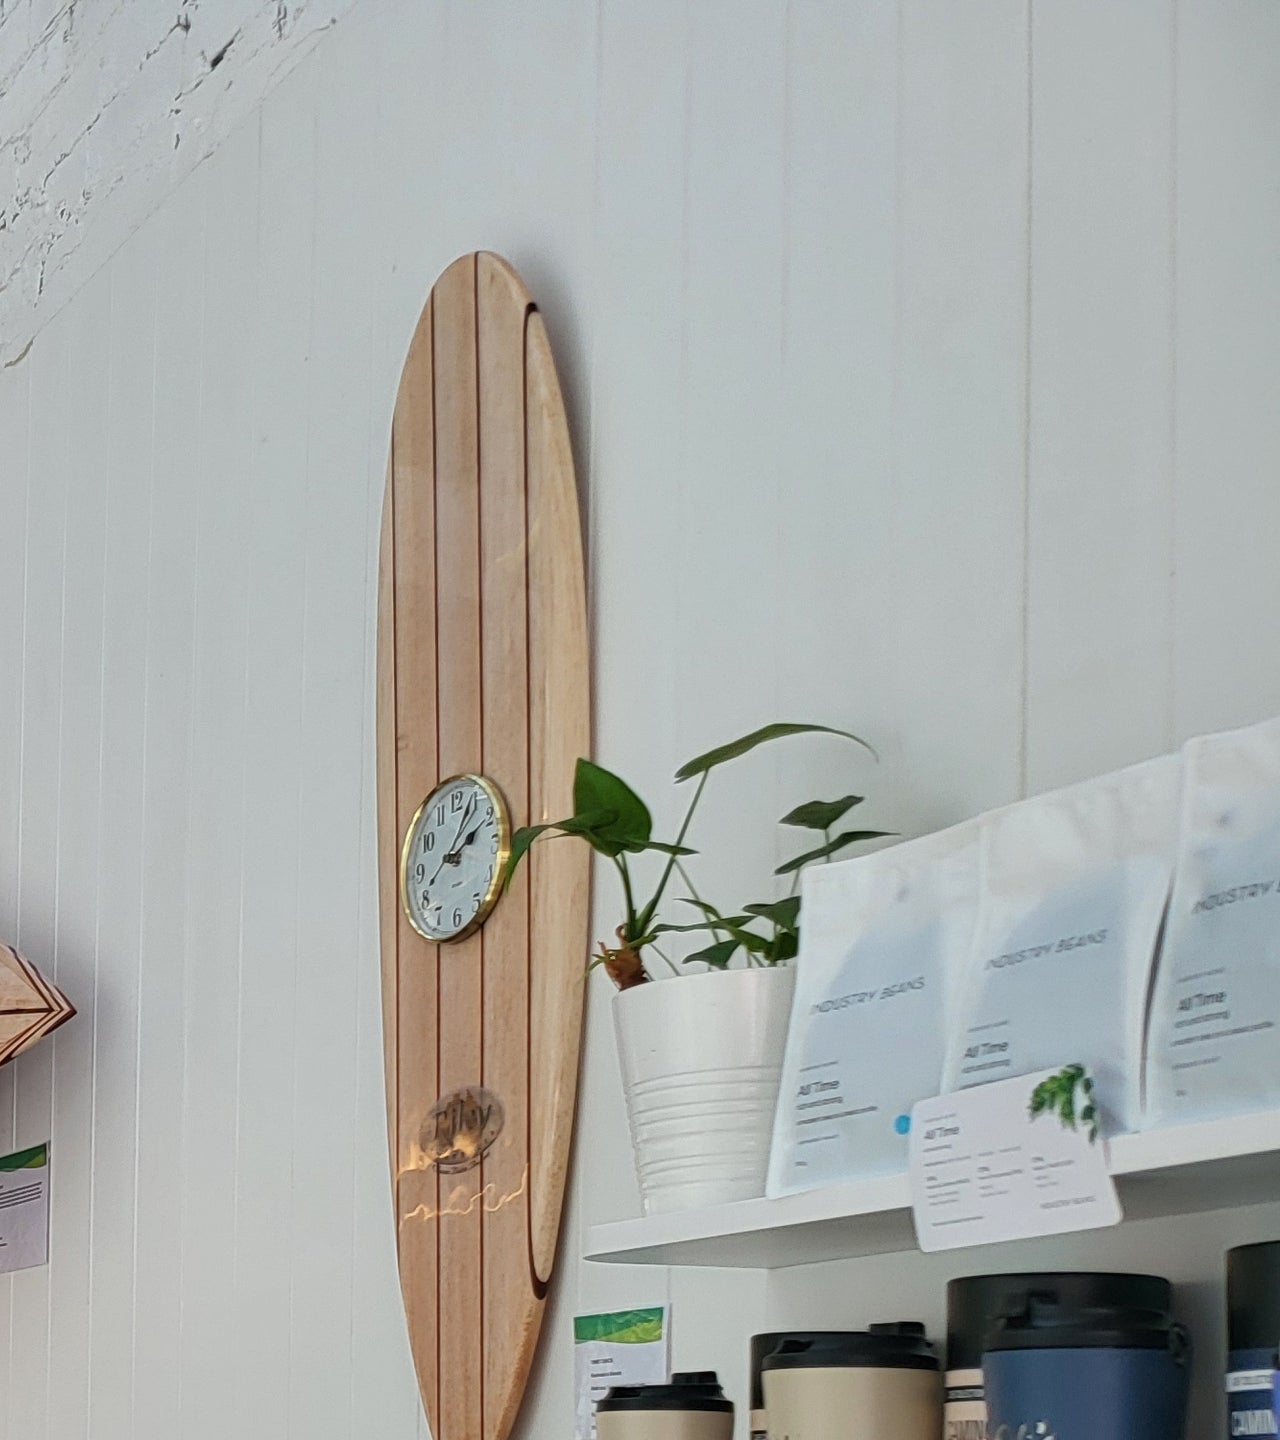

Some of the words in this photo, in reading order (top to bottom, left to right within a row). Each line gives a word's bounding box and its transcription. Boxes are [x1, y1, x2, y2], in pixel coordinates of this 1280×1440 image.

[451, 790, 463, 814] 12
[423, 831, 435, 853] 10
[416, 863, 425, 884] 9
[421, 889, 430, 910] 8
[452, 907, 462, 927] 6
[1232, 1409, 1278, 1436] CAMIN
